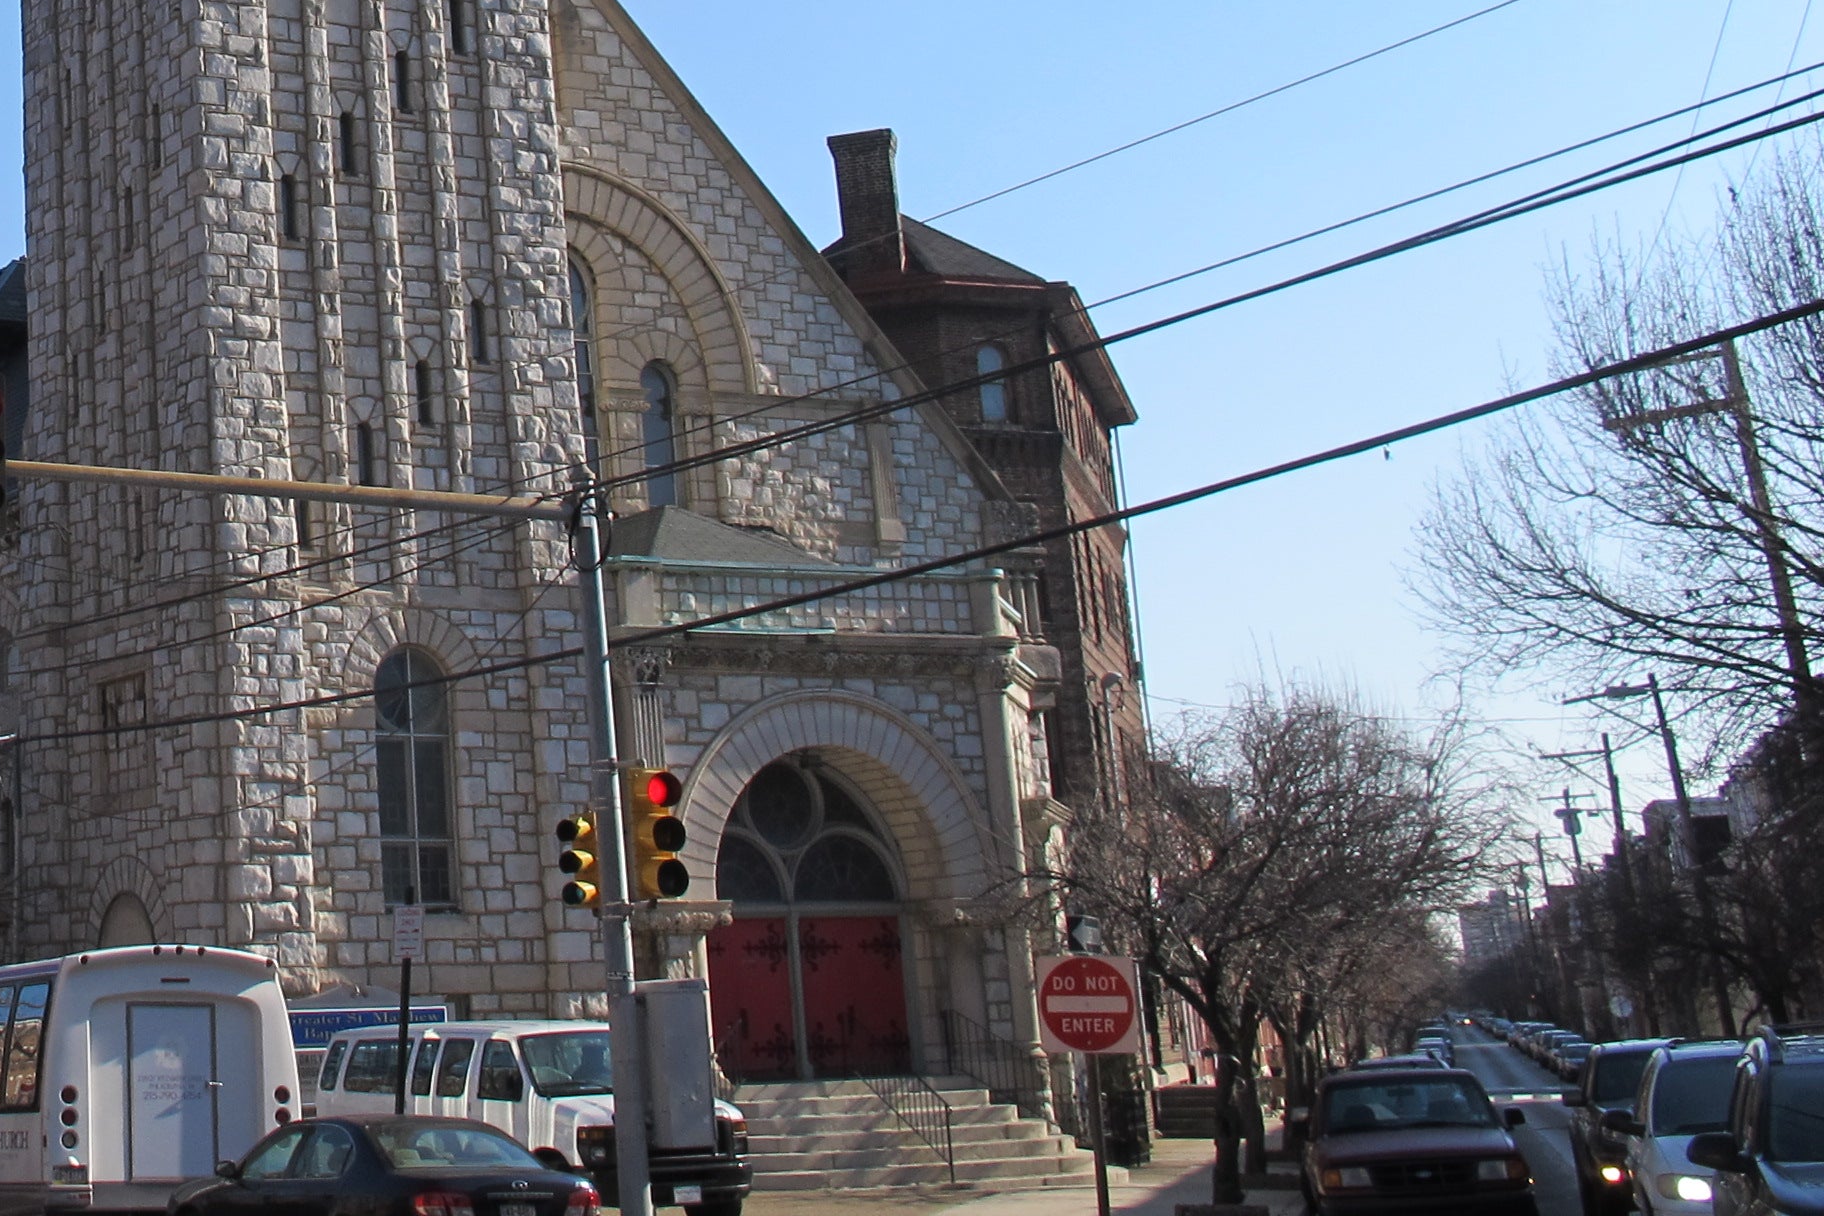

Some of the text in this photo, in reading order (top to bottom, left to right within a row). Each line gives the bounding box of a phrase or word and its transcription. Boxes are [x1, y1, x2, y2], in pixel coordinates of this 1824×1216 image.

[1053, 976, 1118, 991] DO NOT
[1062, 1018, 1115, 1033] ENTER
